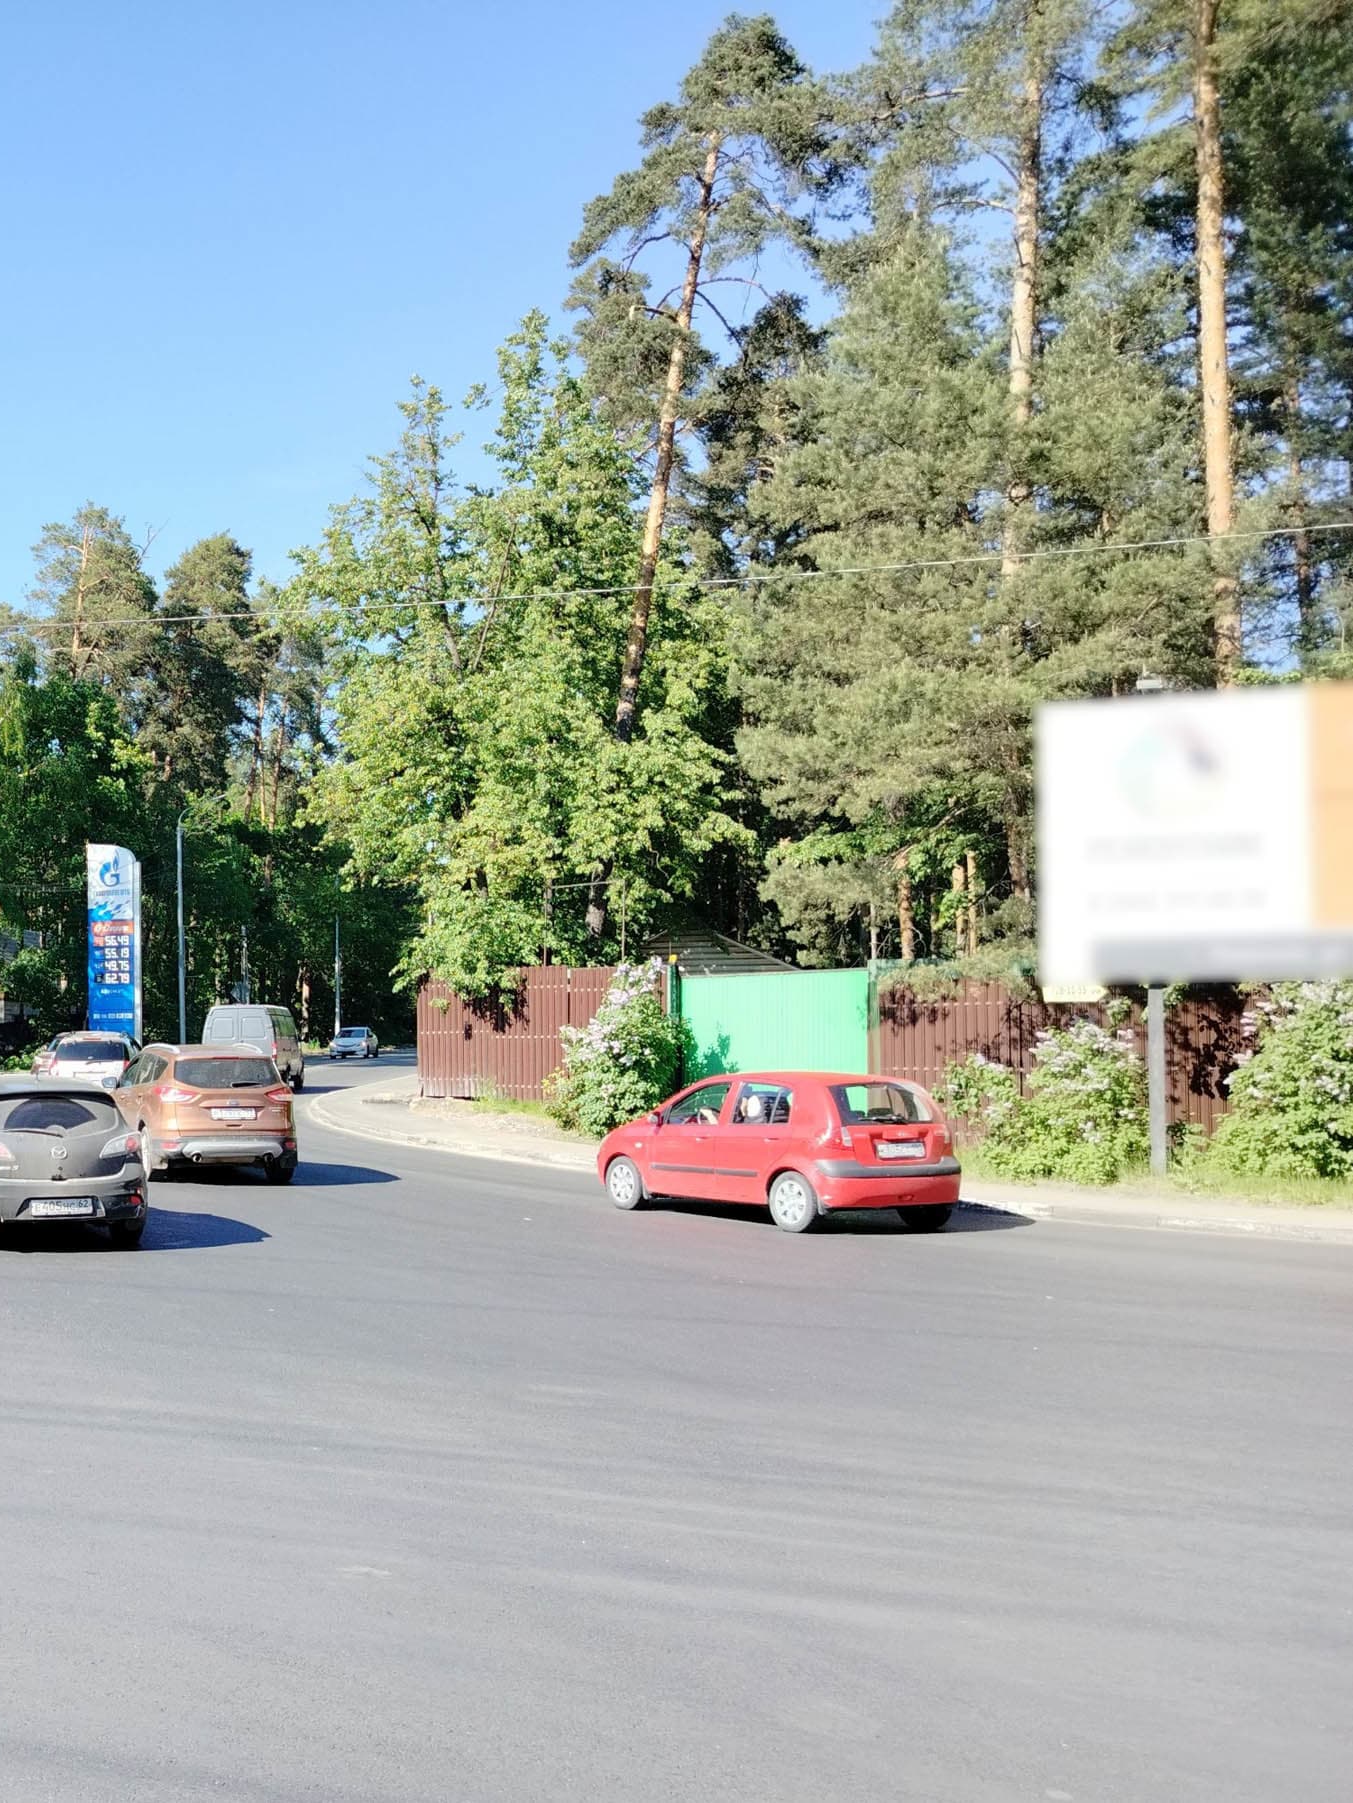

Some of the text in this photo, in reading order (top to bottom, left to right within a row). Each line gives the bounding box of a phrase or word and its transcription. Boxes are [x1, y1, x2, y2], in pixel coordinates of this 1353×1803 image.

[104, 947, 130, 958] 55.19
[104, 960, 130, 971] 49.75
[78, 1199, 89, 1208] 62
